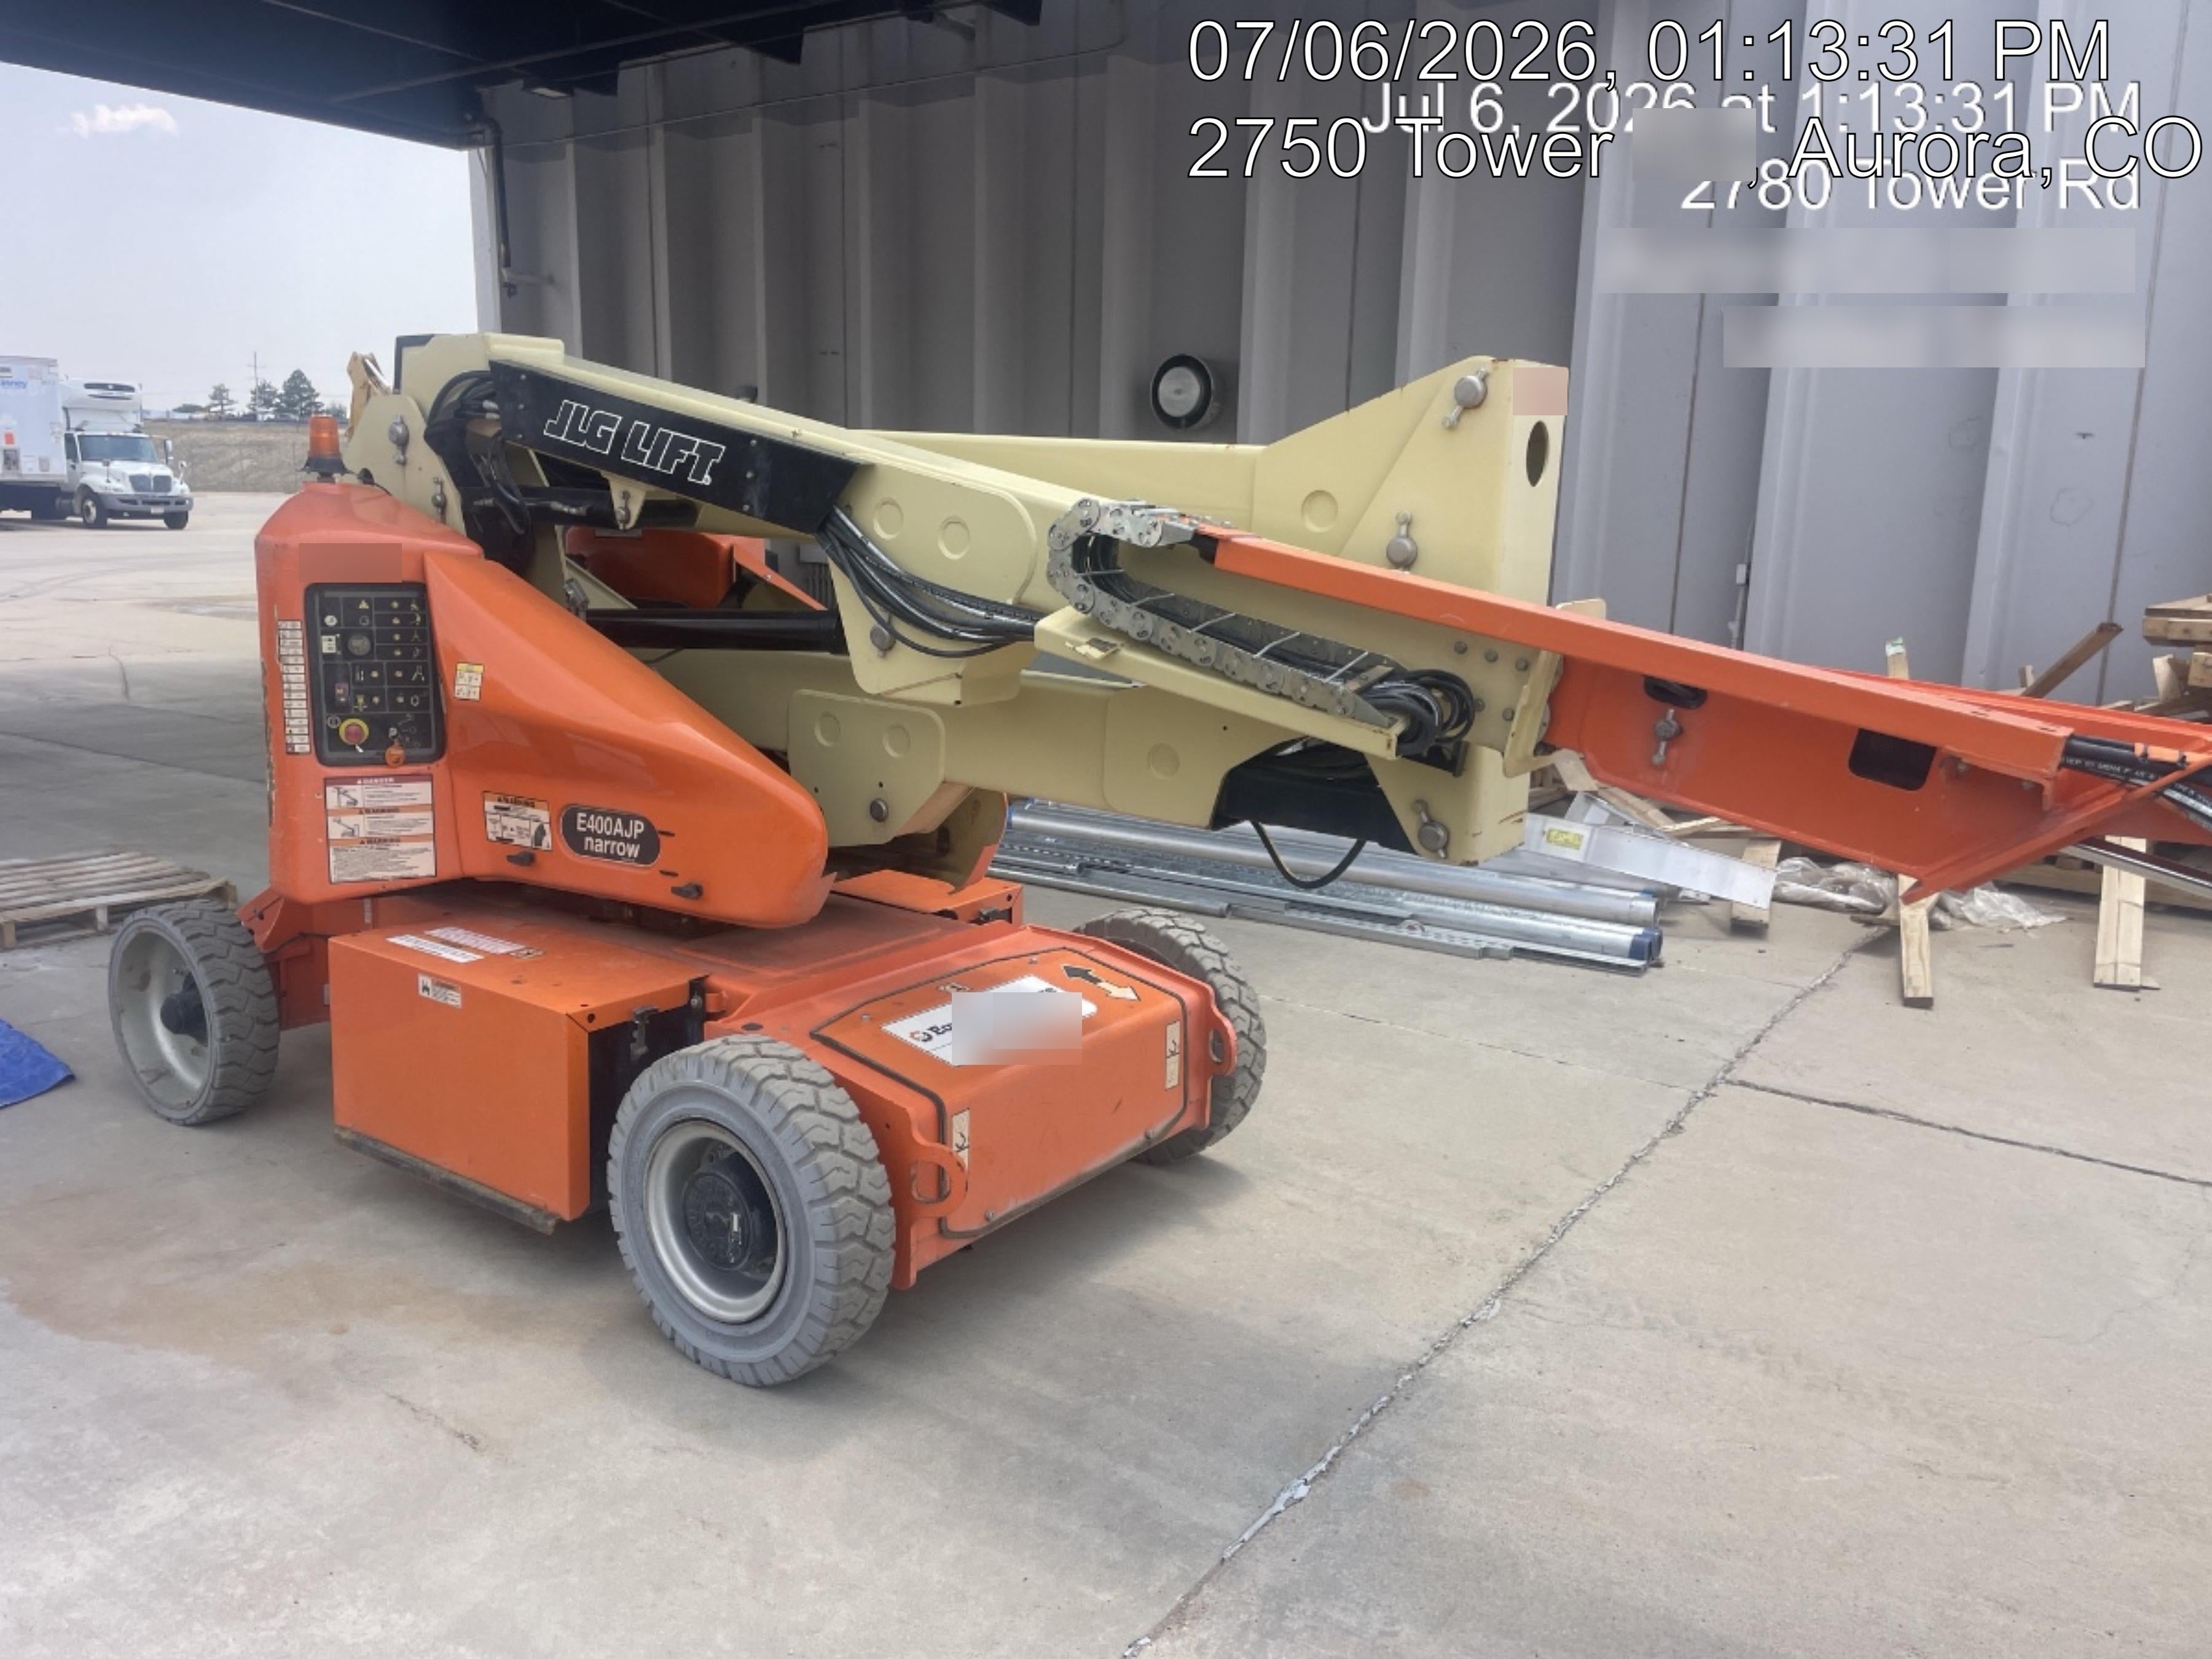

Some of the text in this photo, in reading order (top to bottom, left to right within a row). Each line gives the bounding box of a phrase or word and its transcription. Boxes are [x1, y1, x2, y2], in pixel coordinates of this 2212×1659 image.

[543, 399, 623, 455] JLG
[576, 812, 645, 839] E400AJP
[584, 836, 640, 858] narrow
